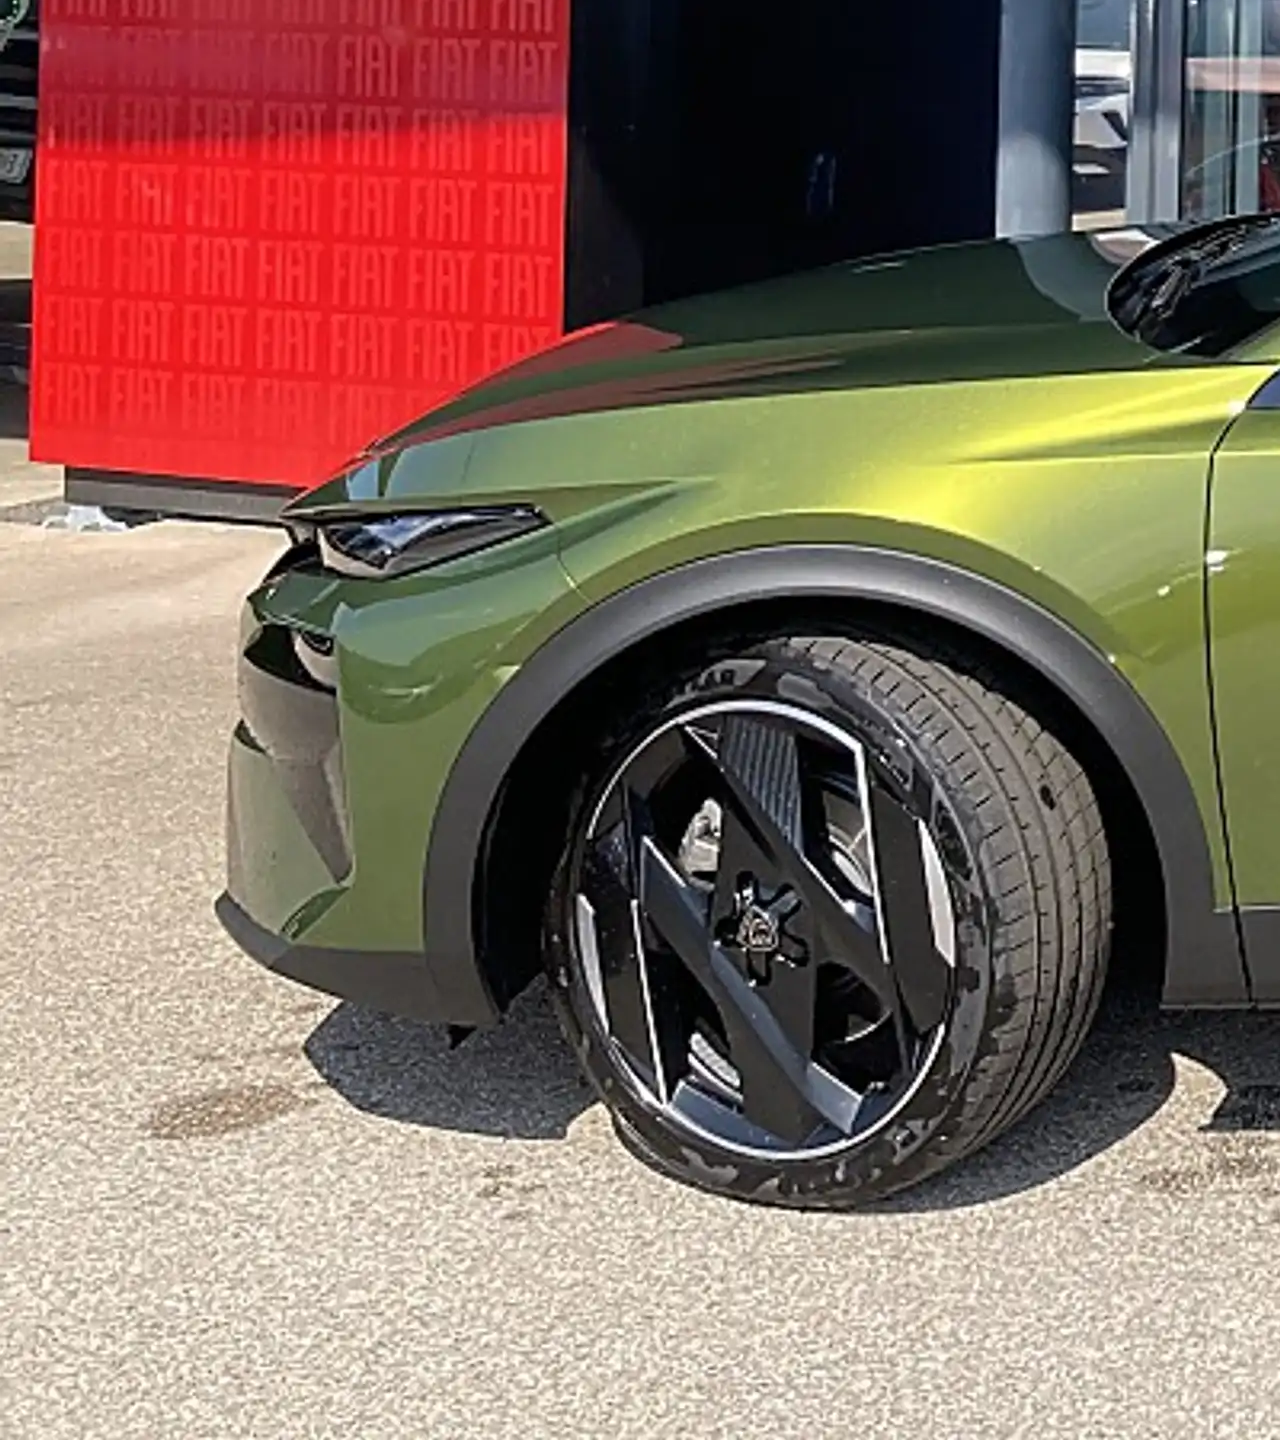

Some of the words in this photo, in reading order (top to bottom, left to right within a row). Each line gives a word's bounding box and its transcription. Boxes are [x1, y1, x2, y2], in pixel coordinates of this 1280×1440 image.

[338, 36, 403, 97] FIAT
[414, 38, 480, 100] FIAT
[490, 41, 557, 103] FIAT
[47, 94, 109, 151] FIAT
[118, 97, 180, 155] FIAT
[190, 100, 253, 159] FIAT
[263, 102, 326, 163] FIAT
[337, 106, 401, 167] FIAT
[412, 109, 478, 171] FIAT
[488, 112, 555, 174] FIAT
[45, 162, 107, 219] FIAT
[188, 168, 251, 228] FIAT
[261, 172, 325, 232] FIAT
[335, 175, 400, 237] FIAT
[410, 179, 476, 241] FIAT
[486, 183, 553, 245] FIAT
[44, 229, 105, 287] FIAT
[114, 233, 176, 292] FIAT
[186, 237, 249, 297] FIAT
[259, 241, 323, 301] FIAT
[333, 245, 398, 306] FIAT
[408, 250, 474, 311] FIAT
[484, 254, 552, 316] FIAT
[42, 297, 103, 354] FIAT
[113, 301, 174, 360] FIAT
[184, 305, 247, 365] FIAT
[257, 310, 321, 371] FIAT
[331, 315, 396, 376] FIAT
[406, 320, 472, 381] FIAT
[40, 364, 101, 422] FIAT
[111, 369, 172, 428] FIAT
